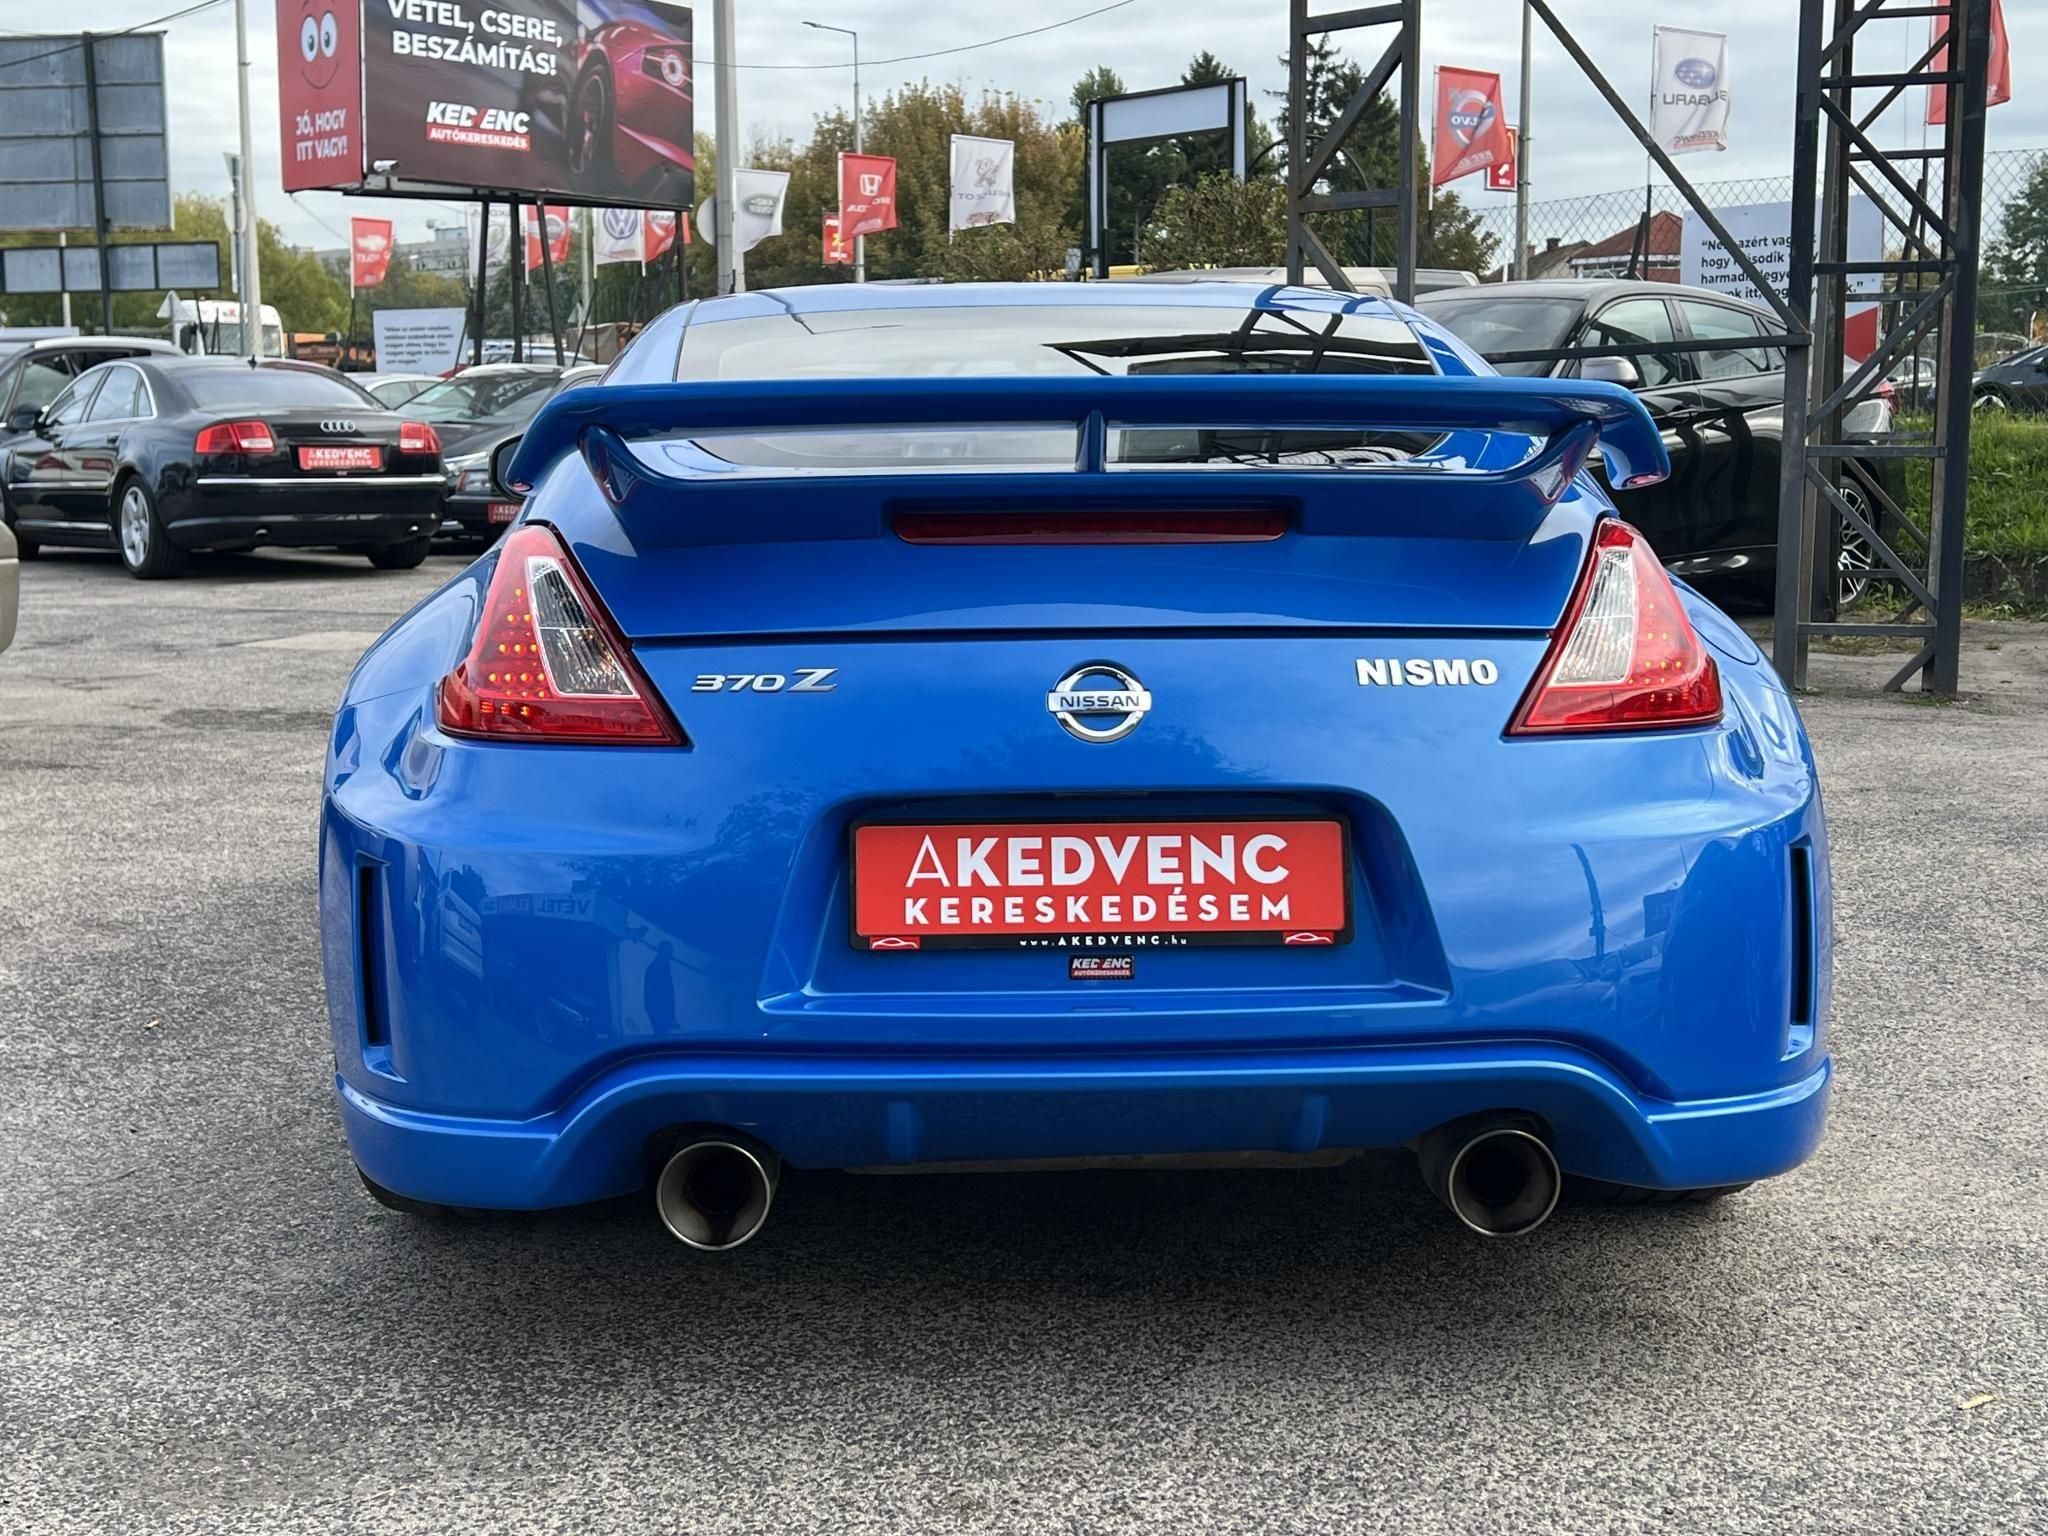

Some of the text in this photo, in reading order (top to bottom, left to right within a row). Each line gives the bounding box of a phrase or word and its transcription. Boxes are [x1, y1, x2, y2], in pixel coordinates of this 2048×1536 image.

[480, 9, 562, 48] CSERE,
[392, 30, 557, 76] BESZÁMÍTÁS!
[295, 108, 346, 137] JÓ, HOGY
[296, 134, 348, 161] ITT VAGY!
[1739, 235, 1768, 249] azért
[1701, 256, 1731, 270] hogy
[1355, 658, 1499, 687] NISMO
[1060, 695, 1140, 708] NISSAN
[905, 833, 1290, 888] AKEDVENC
[905, 887, 1291, 925] KERESKEDÉSEM
[1019, 934, 1188, 947] www.AKEDVENC.hu
